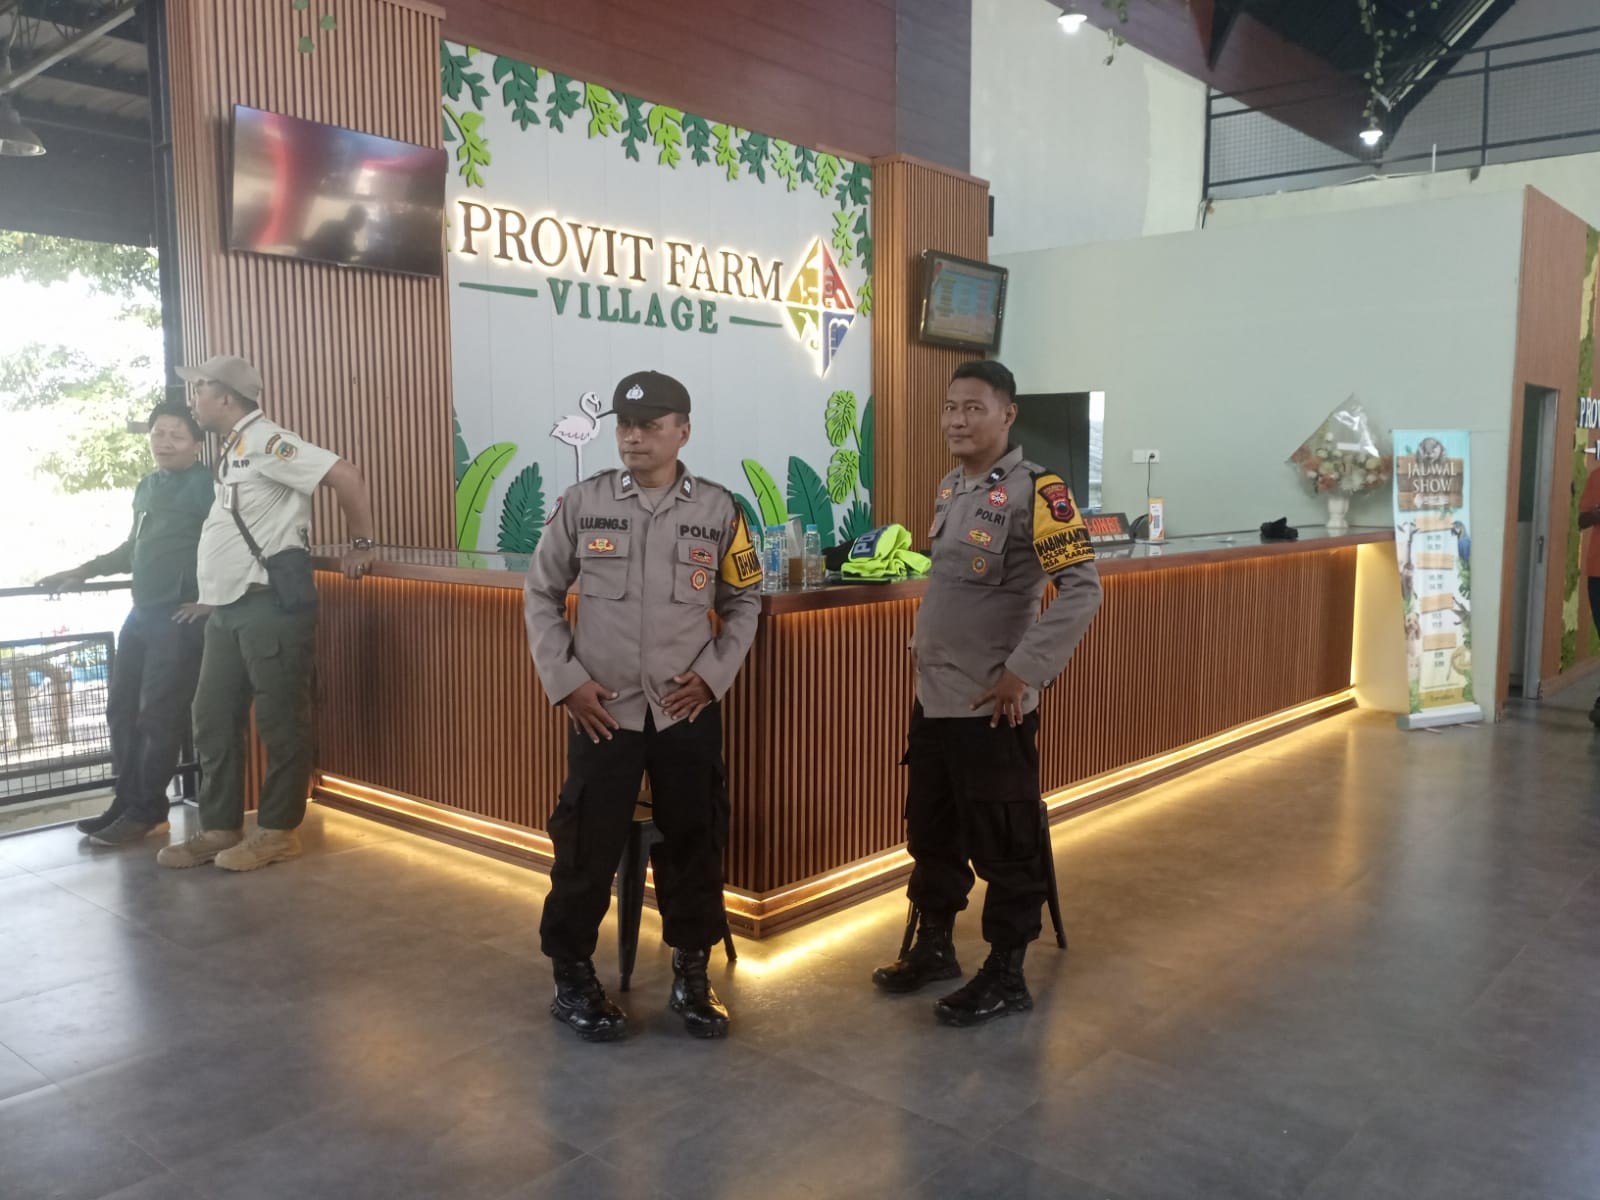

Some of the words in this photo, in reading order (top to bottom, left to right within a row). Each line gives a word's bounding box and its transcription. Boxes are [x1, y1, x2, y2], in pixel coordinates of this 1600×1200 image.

[457, 200, 654, 282] PROVIT
[664, 241, 784, 302] FARM
[546, 277, 719, 334] VILLAGE
[1412, 477, 1452, 493] SHOW
[975, 507, 1006, 527] POLRI
[679, 524, 721, 542] POLRI
